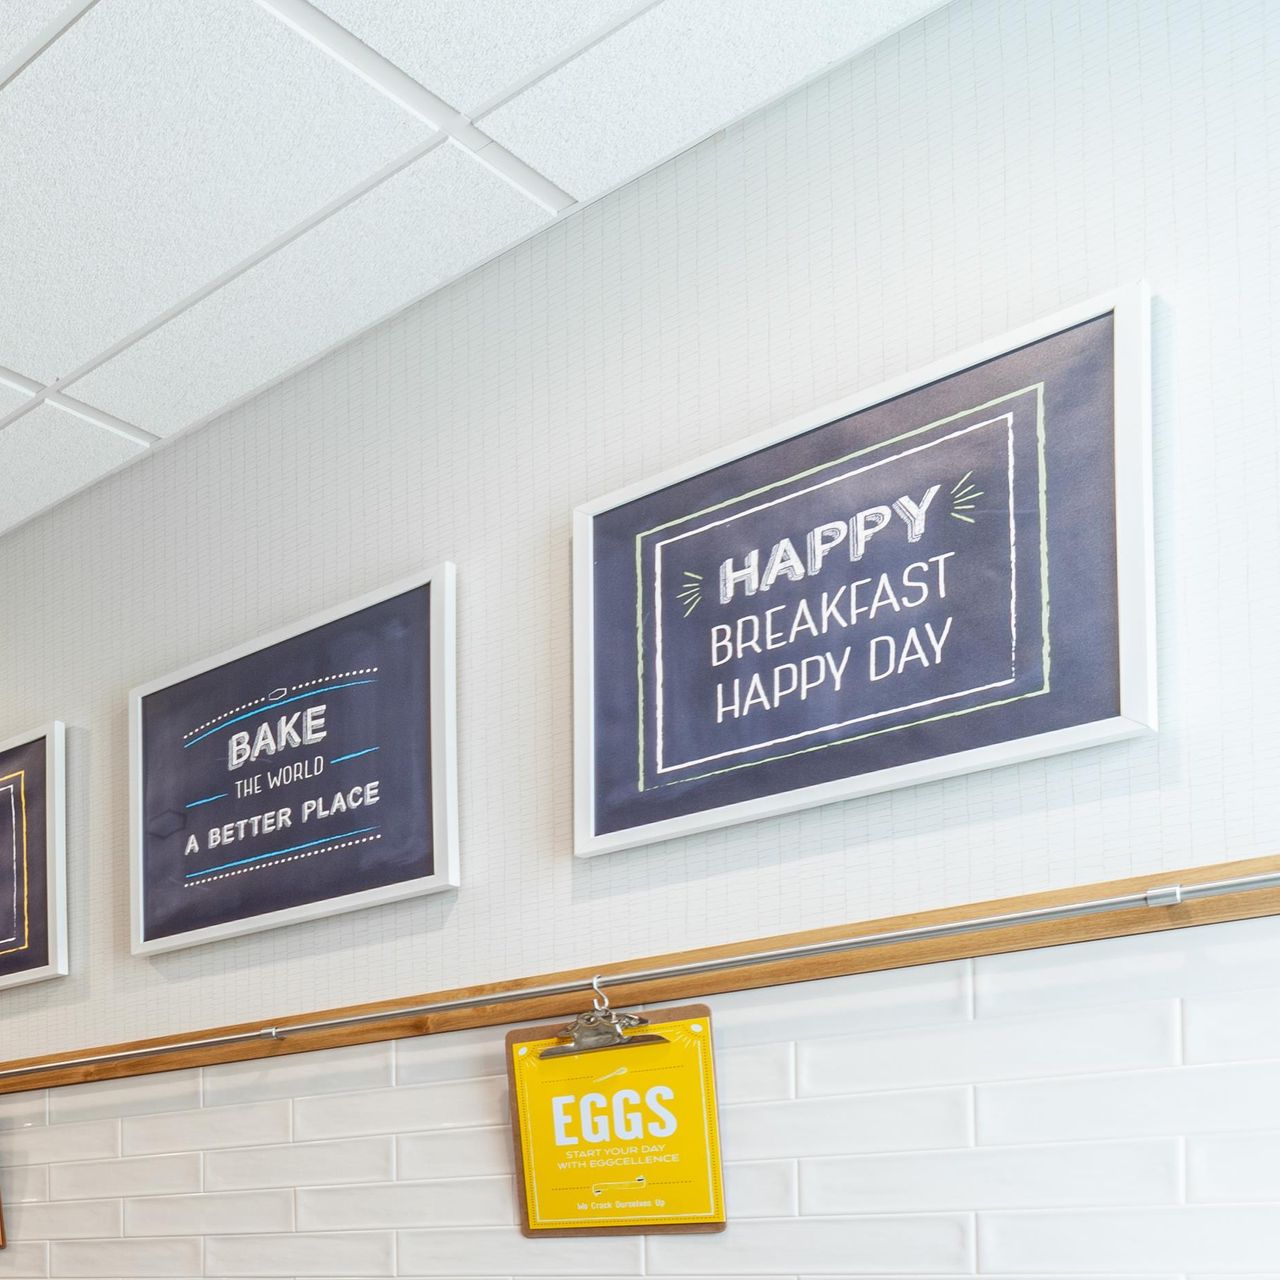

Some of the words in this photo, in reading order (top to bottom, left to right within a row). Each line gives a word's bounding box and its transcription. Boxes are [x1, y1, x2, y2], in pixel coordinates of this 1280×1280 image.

[719, 484, 941, 605] HAPPY
[711, 551, 955, 667] BREAKFAST
[717, 646, 851, 723] HAPPY
[869, 616, 953, 682] DAY
[228, 704, 327, 771] BAKE
[235, 774, 262, 799] THE
[268, 755, 324, 789] WORLD
[184, 834, 200, 855] A
[208, 807, 292, 849] BETTER
[302, 781, 380, 823] PLACE
[551, 1085, 678, 1146] EGGS
[557, 1160, 587, 1169] WITH
[590, 1153, 680, 1168] EGGCELLENCE
[565, 1149, 601, 1159] START
[604, 1146, 638, 1156] YOUR
[641, 1144, 666, 1153] DAY
